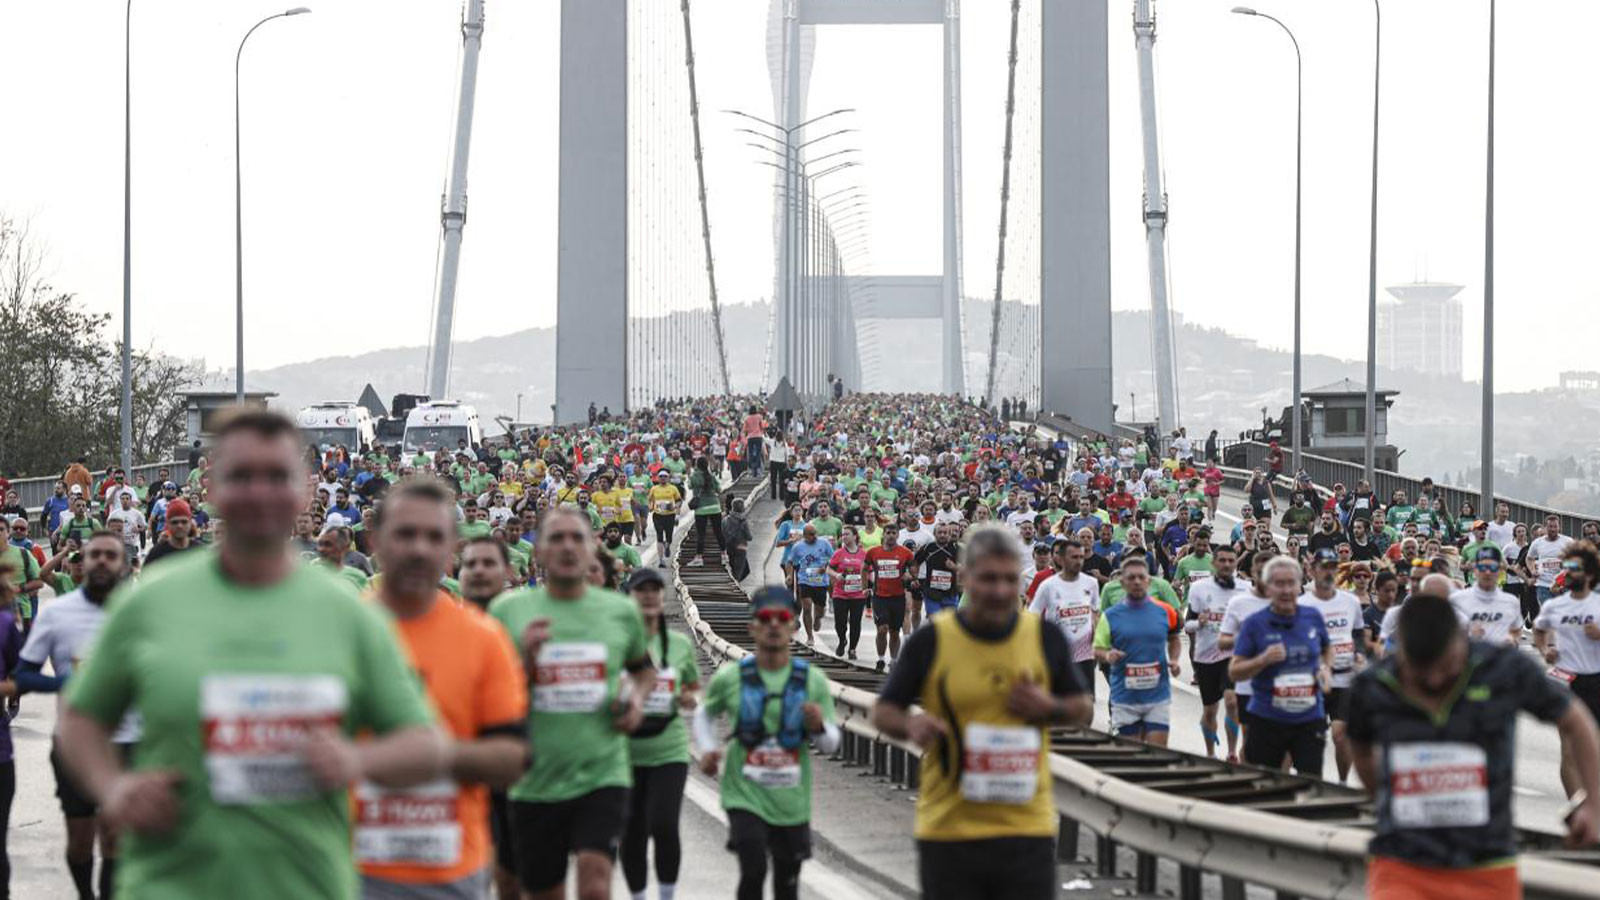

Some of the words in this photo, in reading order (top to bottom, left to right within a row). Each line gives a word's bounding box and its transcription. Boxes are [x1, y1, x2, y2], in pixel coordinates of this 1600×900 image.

[1471, 612, 1503, 622] BOLD
[1561, 615, 1594, 625] BOLD
[1326, 618, 1348, 628] OLD
